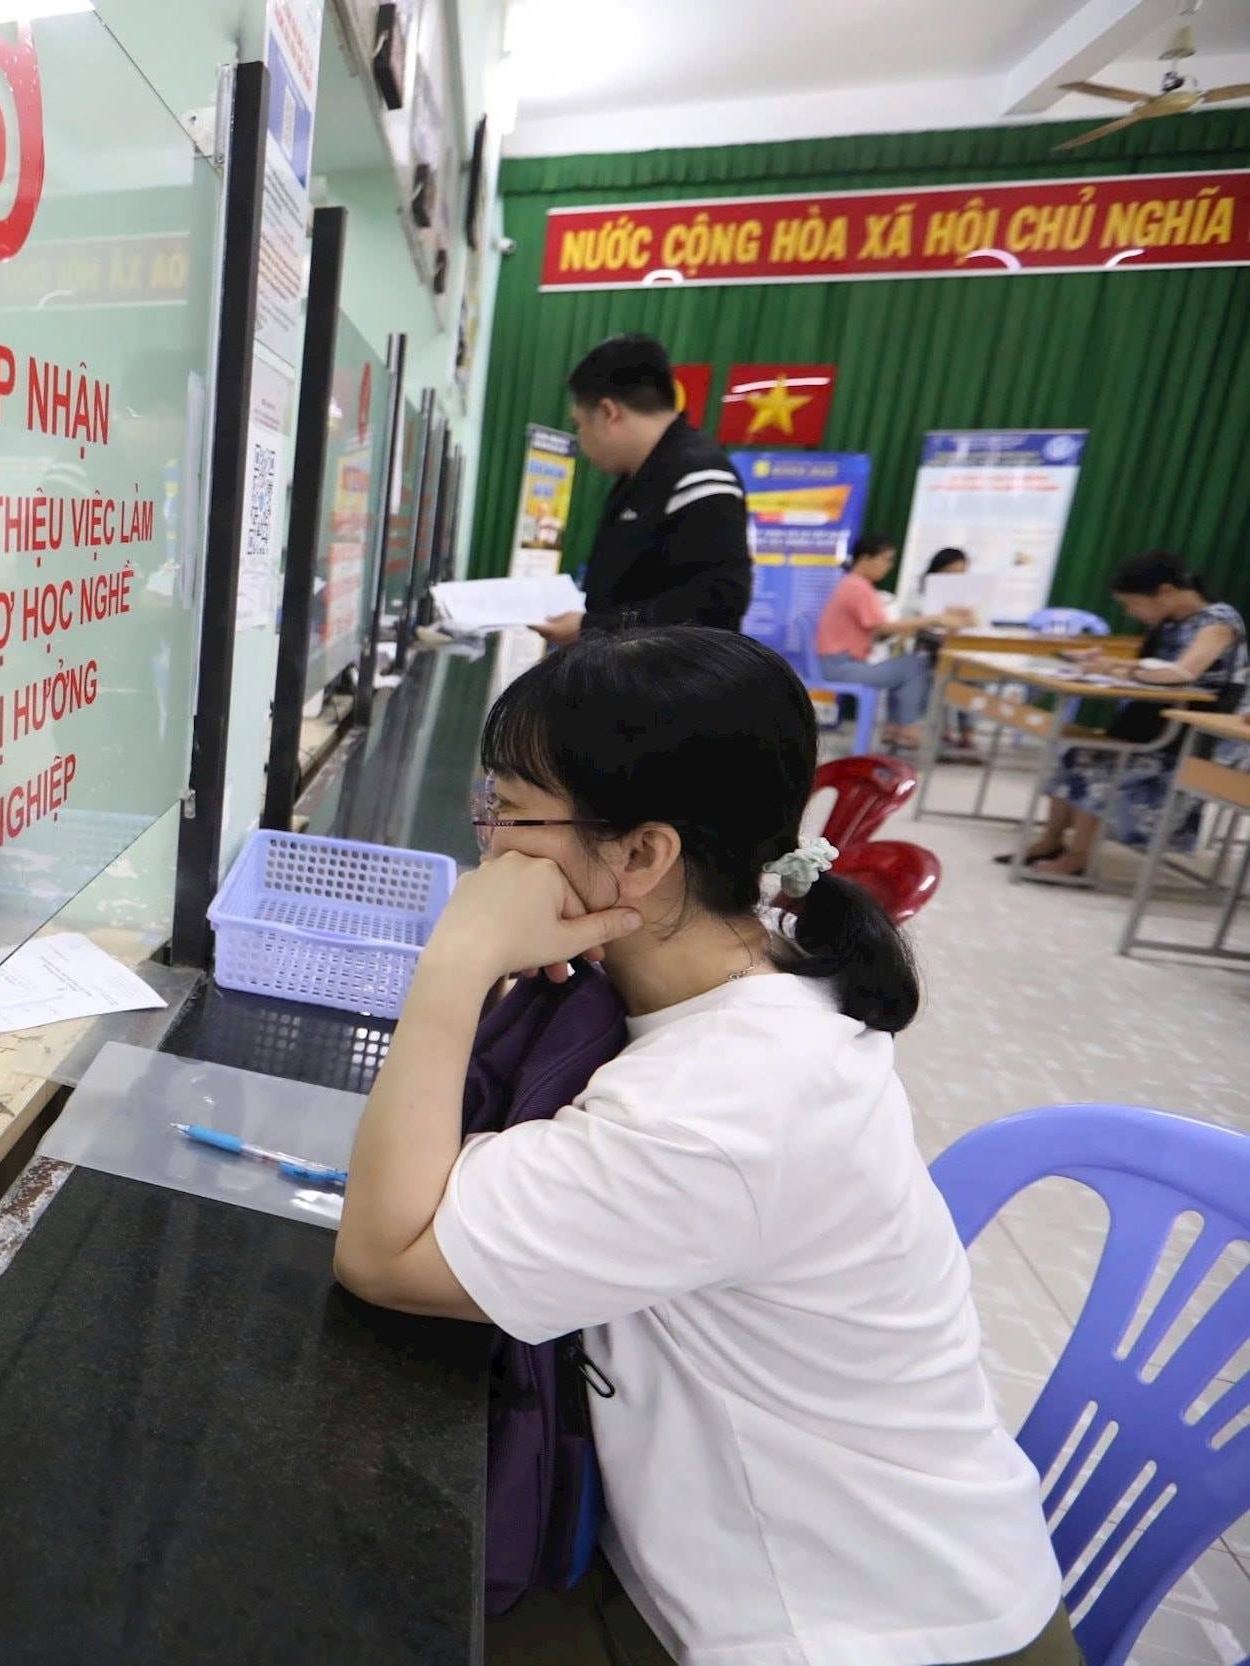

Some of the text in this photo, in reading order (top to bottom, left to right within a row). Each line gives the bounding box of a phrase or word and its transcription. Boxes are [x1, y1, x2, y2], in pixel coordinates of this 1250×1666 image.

[559, 185, 1236, 277] NƯỚC CỘNG HÒA XÃ HỘI CHỦ NGHĨA
[27, 356, 111, 458] NHẬN
[71, 489, 117, 561] VIỆC
[120, 483, 155, 545] LÀM
[22, 579, 74, 654] HỌC
[79, 560, 135, 626] NGHỀ
[13, 659, 99, 742] HƯỞNG
